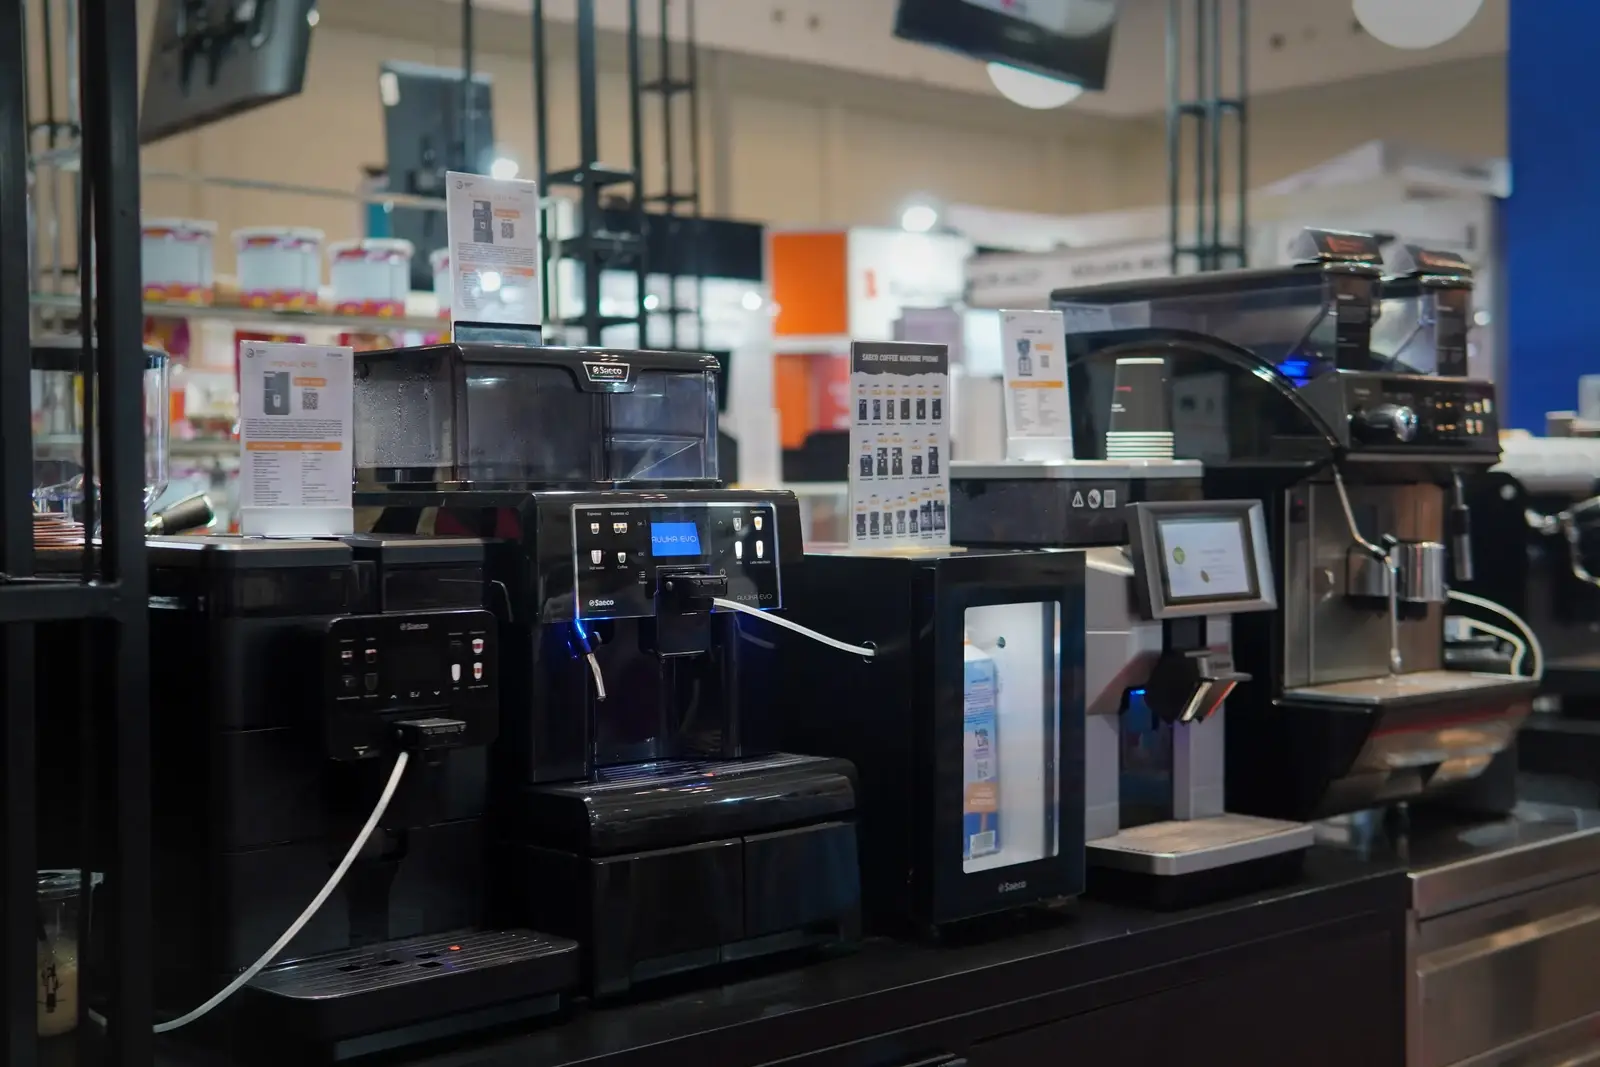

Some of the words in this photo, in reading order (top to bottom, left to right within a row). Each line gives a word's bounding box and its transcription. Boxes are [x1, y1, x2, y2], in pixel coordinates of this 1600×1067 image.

[861, 353, 879, 361] SAECO
[879, 354, 899, 362] COFFEE
[599, 366, 622, 375] Saeco
[681, 535, 697, 543] EVO
[406, 622, 429, 630] Saeco
[1004, 879, 1027, 892] Saeco
